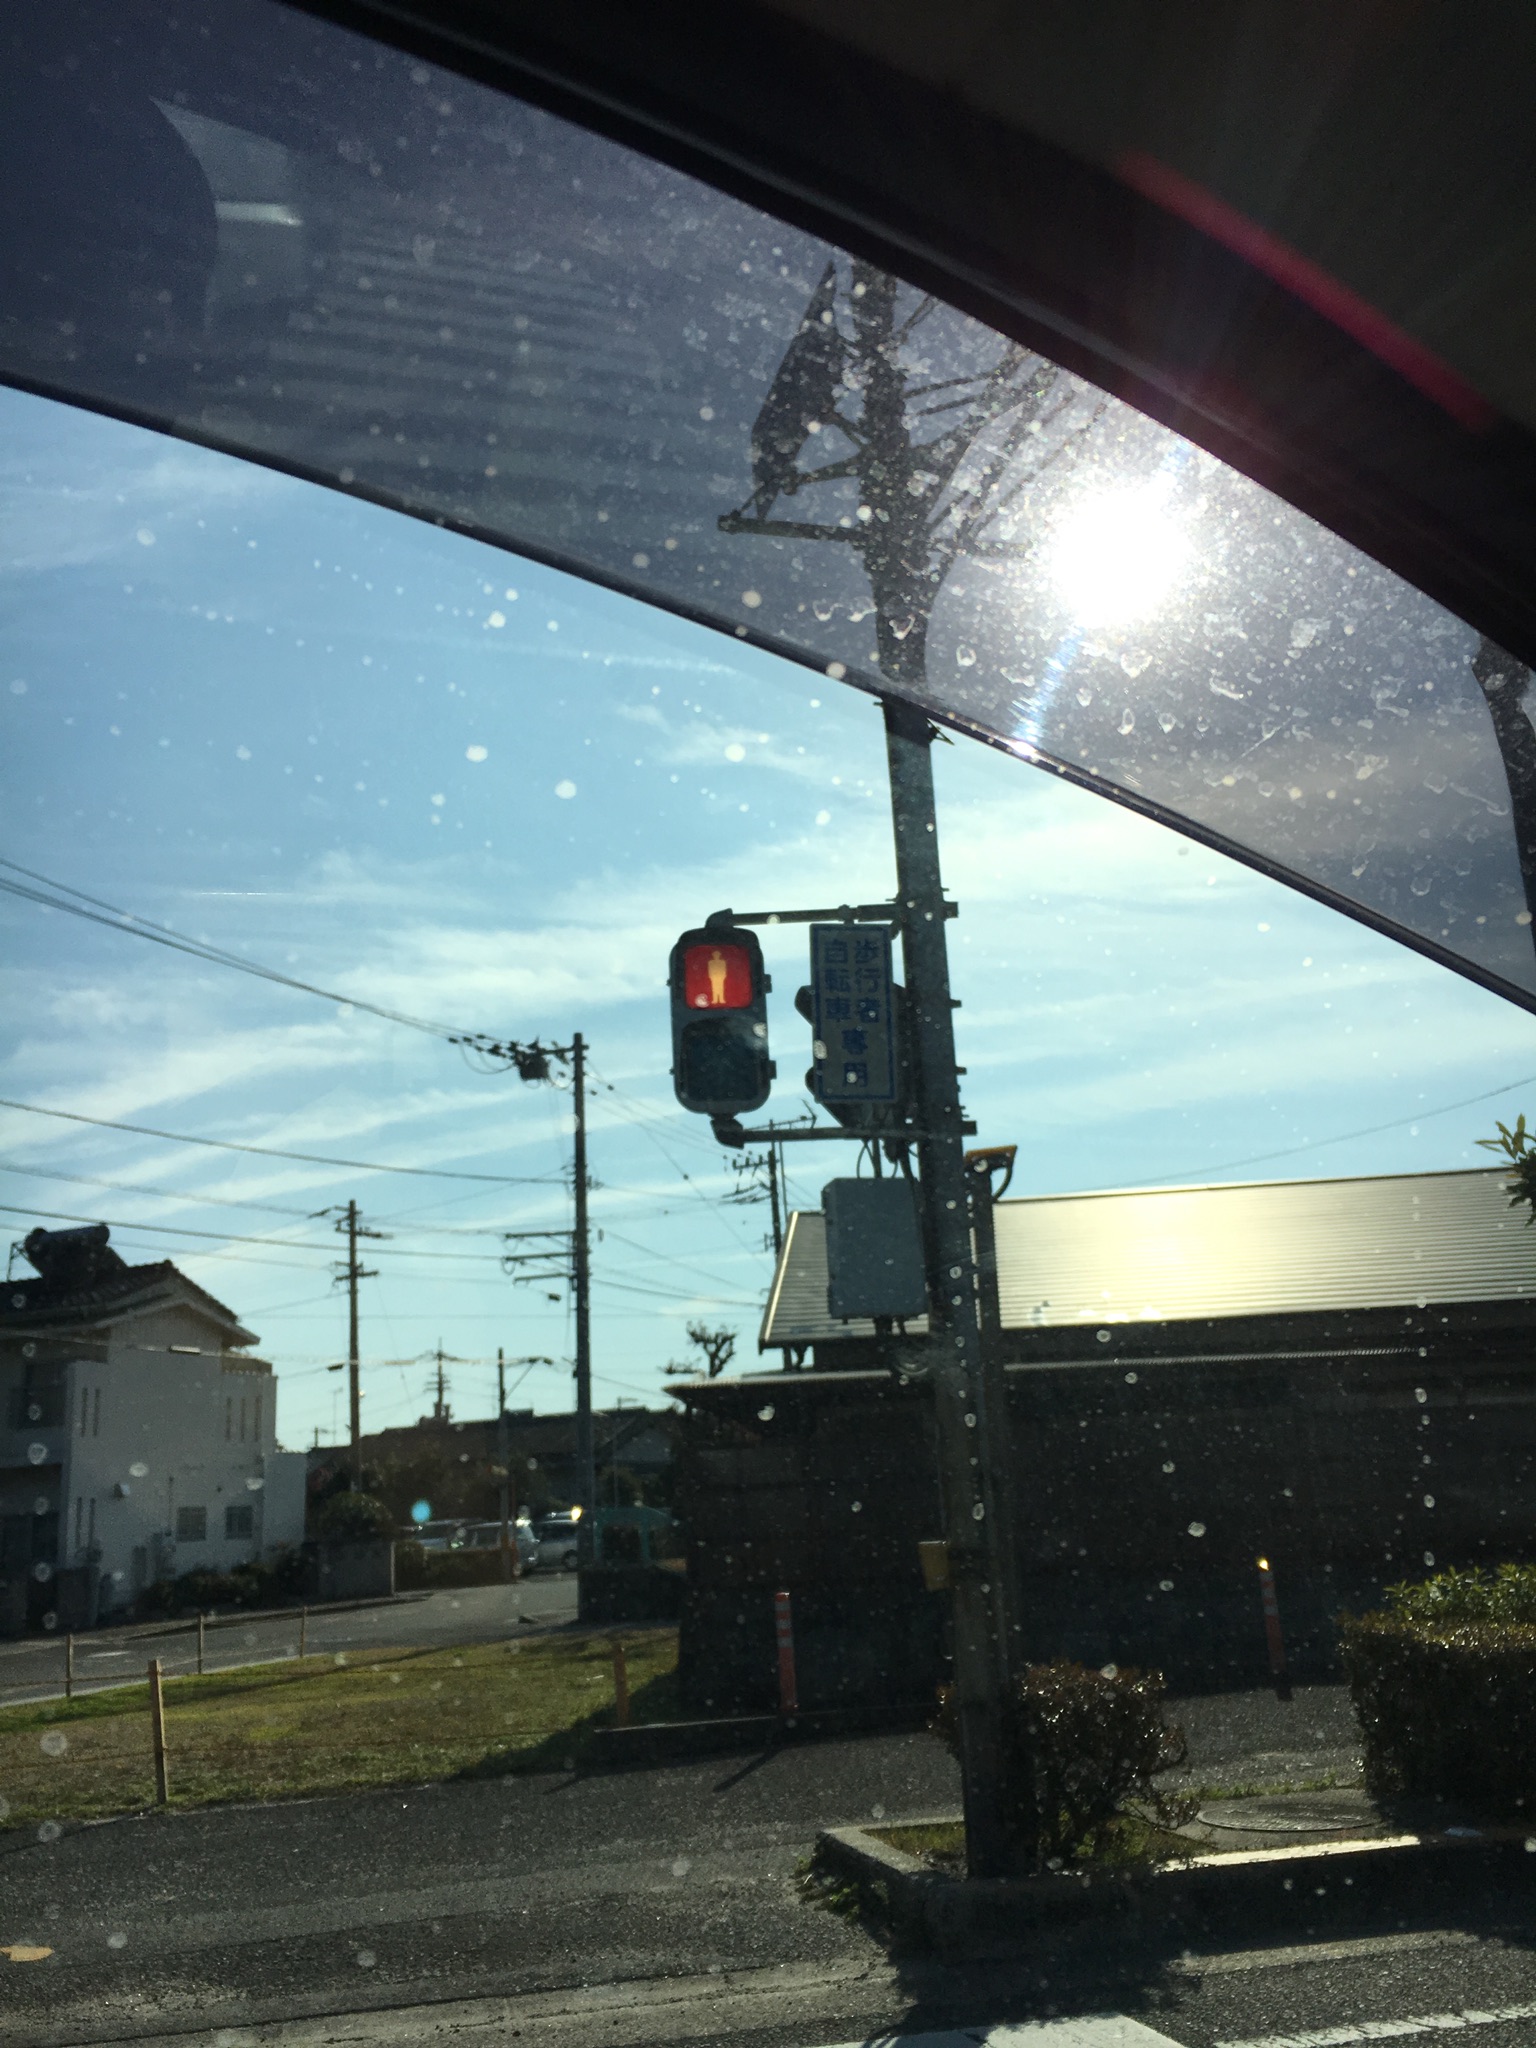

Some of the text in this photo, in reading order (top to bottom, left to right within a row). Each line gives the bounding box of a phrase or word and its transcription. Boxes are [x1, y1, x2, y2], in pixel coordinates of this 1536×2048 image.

[824, 939, 851, 1022] 自転車
[855, 938, 880, 1023] 歩行者
[841, 1029, 869, 1088] 専用
